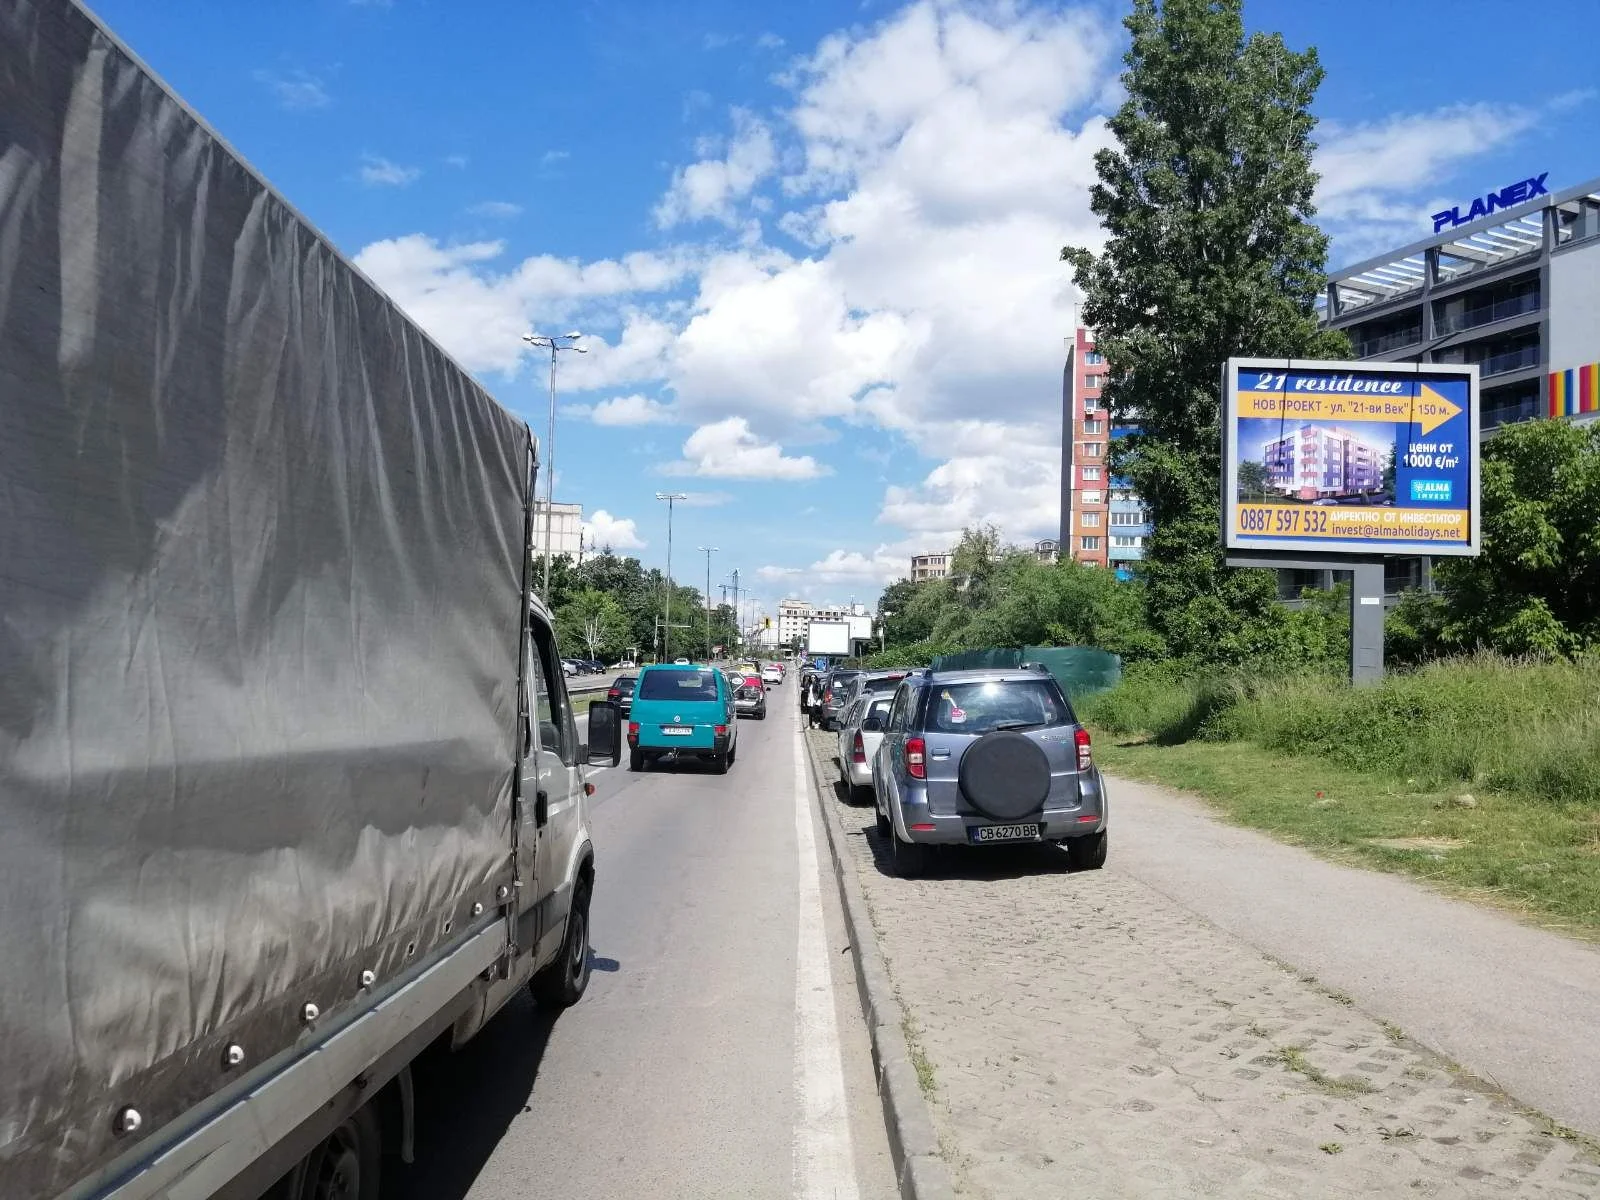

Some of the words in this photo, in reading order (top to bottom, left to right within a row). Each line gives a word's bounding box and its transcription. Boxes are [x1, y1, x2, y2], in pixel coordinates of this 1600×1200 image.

[1431, 172, 1549, 233] PLANEX
[1255, 372, 1288, 390] 21
[1295, 374, 1403, 393] residence
[1253, 399, 1276, 410] НОВ
[1279, 400, 1322, 411] ПРОЕКТ
[1330, 403, 1346, 415] ул.
[1348, 401, 1382, 413] "21-ви
[1384, 403, 1409, 414] Век"
[1418, 404, 1436, 415] 150
[1439, 408, 1450, 416] м.
[1409, 443, 1437, 455] цени
[1439, 443, 1453, 453] от
[1403, 454, 1433, 468] 1000
[1425, 483, 1449, 491] ALMA
[1240, 508, 1272, 531] 0887
[1276, 509, 1300, 532] 597
[1303, 510, 1327, 533] 532
[1330, 511, 1380, 522] ДИРЕКТНО
[1383, 512, 1397, 523] ОТ
[1400, 512, 1462, 525] ИНВЕСТИТОР
[1332, 523, 1461, 539] invest@almaholidays.net
[980, 828, 994, 840] CB
[996, 826, 1021, 838] 6270
[1023, 825, 1037, 836] BB
